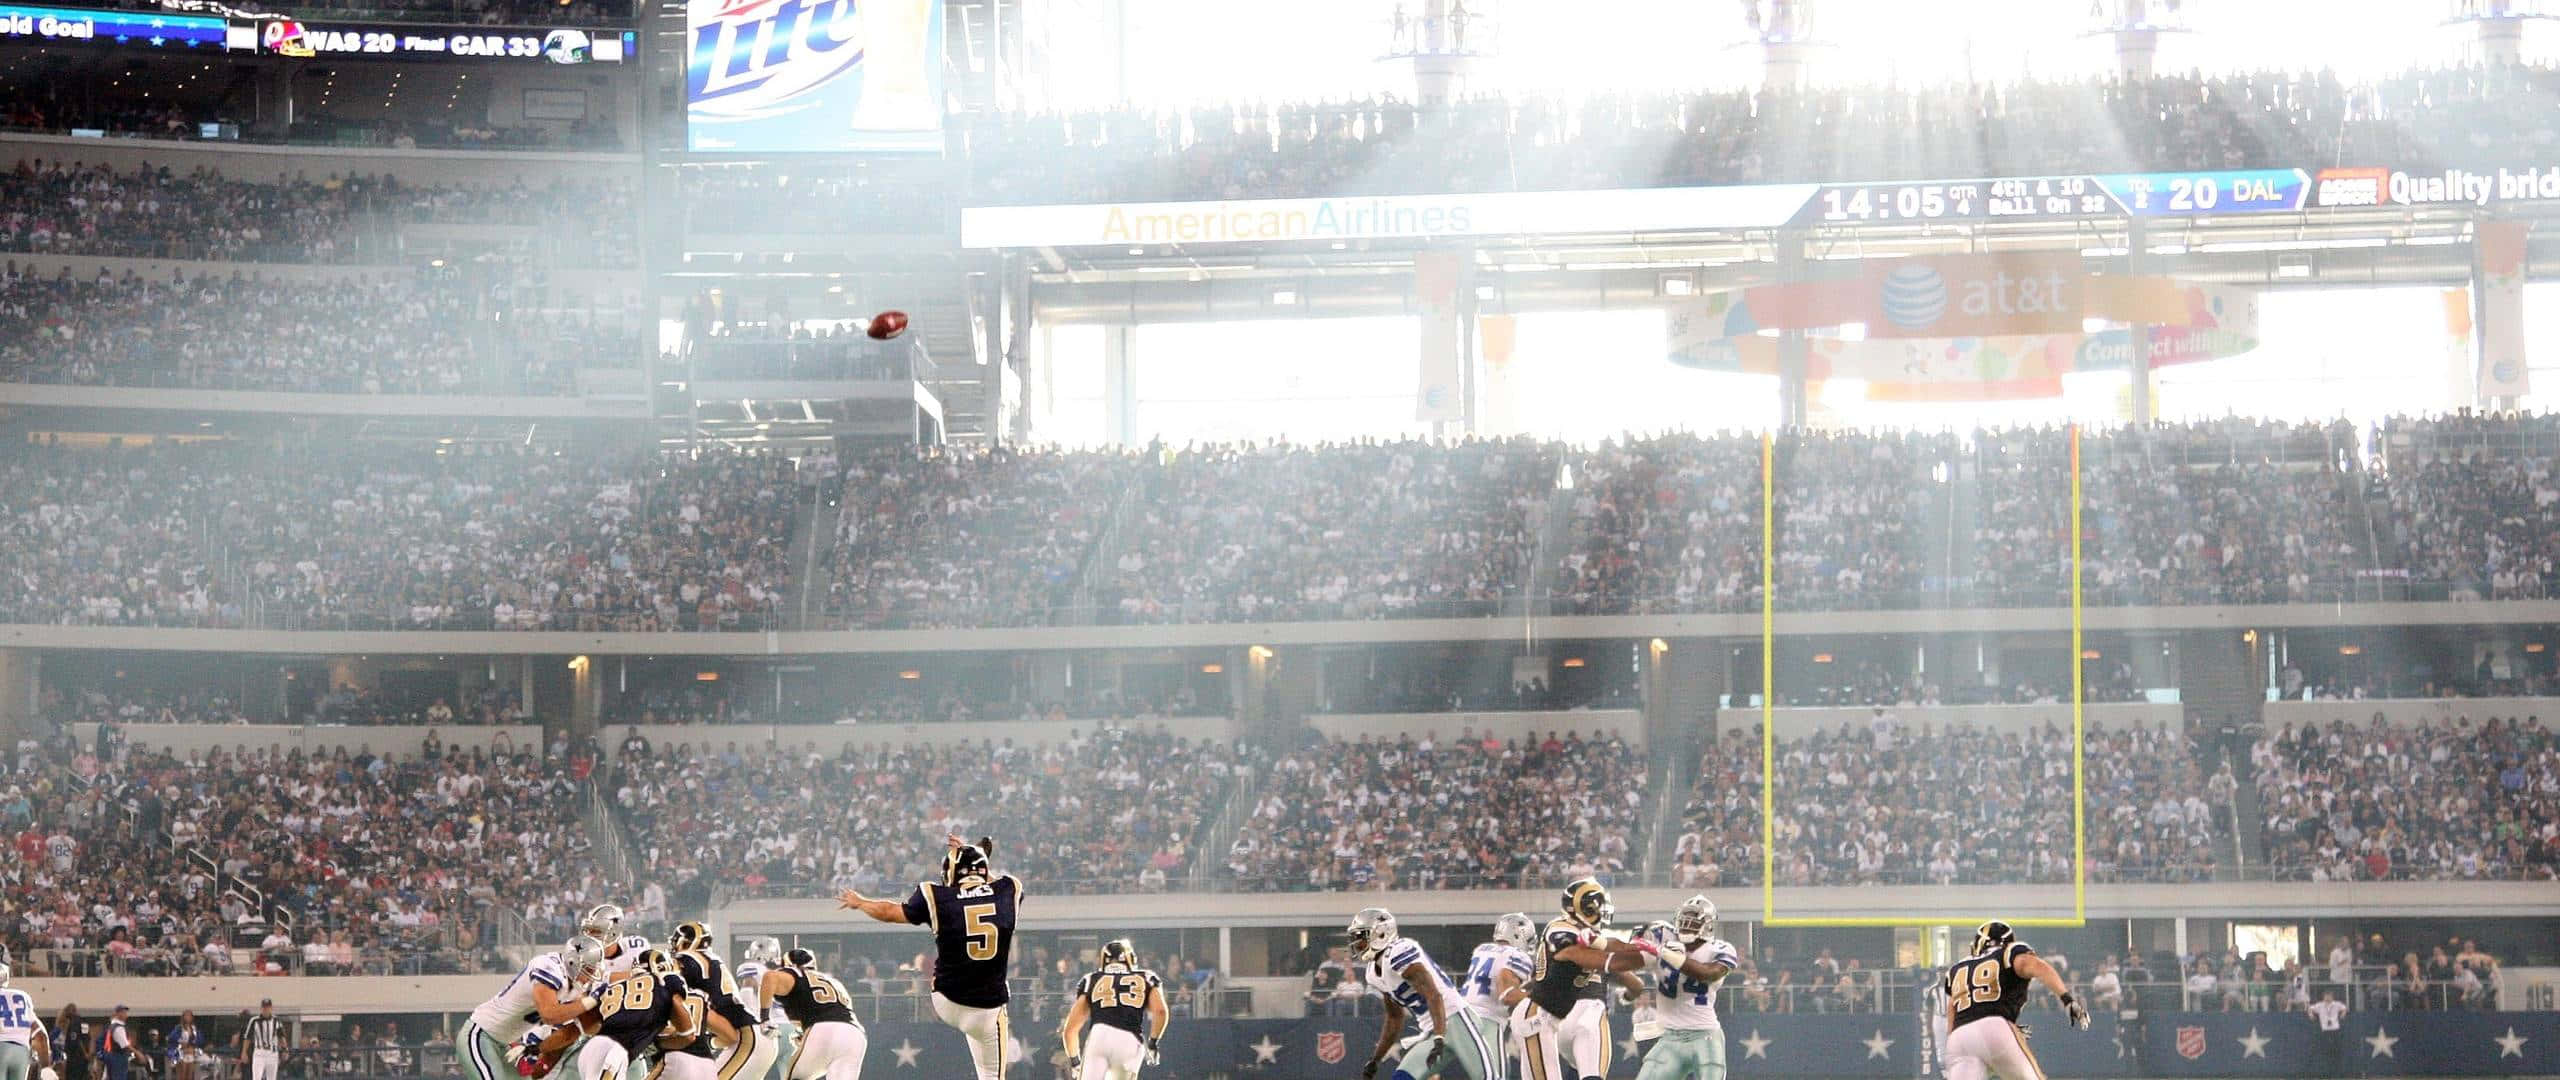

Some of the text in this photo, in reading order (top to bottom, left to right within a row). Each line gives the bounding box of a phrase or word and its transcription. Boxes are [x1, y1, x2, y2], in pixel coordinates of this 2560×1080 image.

[39, 16, 94, 38] Goal
[303, 31, 360, 52] WAS
[363, 33, 396, 53] 20
[452, 35, 505, 57] CAR
[508, 37, 541, 57] 33
[687, 0, 859, 104] Lite
[1823, 185, 1945, 220] 14:05
[2060, 176, 2085, 196] 10
[2168, 178, 2283, 210] 20 DAL
[2388, 169, 2492, 206] Quality
[1960, 270, 2069, 315] at&t
[964, 903, 999, 961] 5
[599, 974, 655, 1021] 88
[1091, 974, 1147, 1009] 43
[1951, 959, 2002, 1012] 49
[0, 994, 33, 1028] 42
